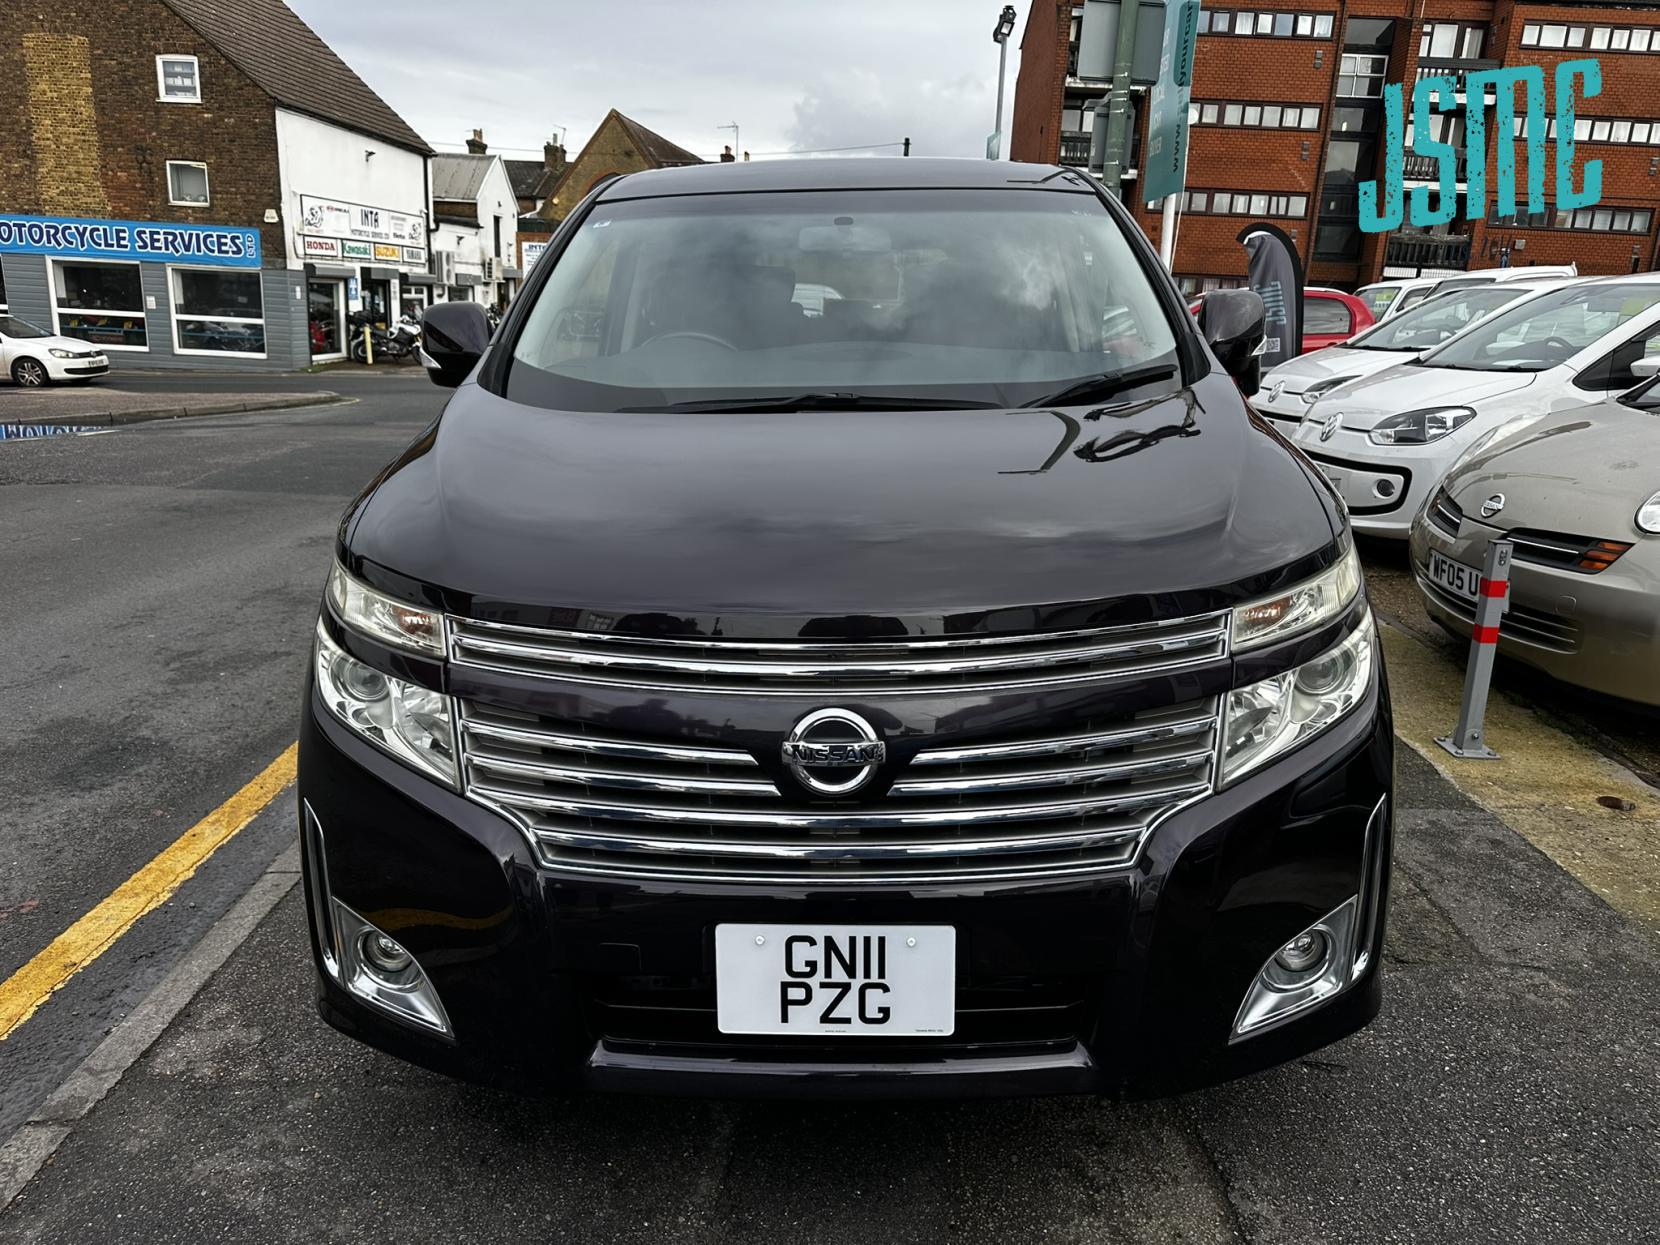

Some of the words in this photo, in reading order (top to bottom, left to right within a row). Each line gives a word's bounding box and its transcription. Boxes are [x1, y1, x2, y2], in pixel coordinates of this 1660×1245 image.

[360, 208, 379, 229] INTA
[0, 220, 130, 252] OTORCYCLE
[135, 228, 245, 258] SERVICES
[246, 234, 256, 259] LTD
[306, 241, 335, 251] HONDA
[343, 242, 371, 256] Kawasaki
[376, 245, 399, 259] SUZUKI
[1433, 554, 1465, 591] WF05
[791, 744, 877, 762] NISSAN
[785, 935, 887, 980] GN11
[780, 981, 891, 1025] PZG
